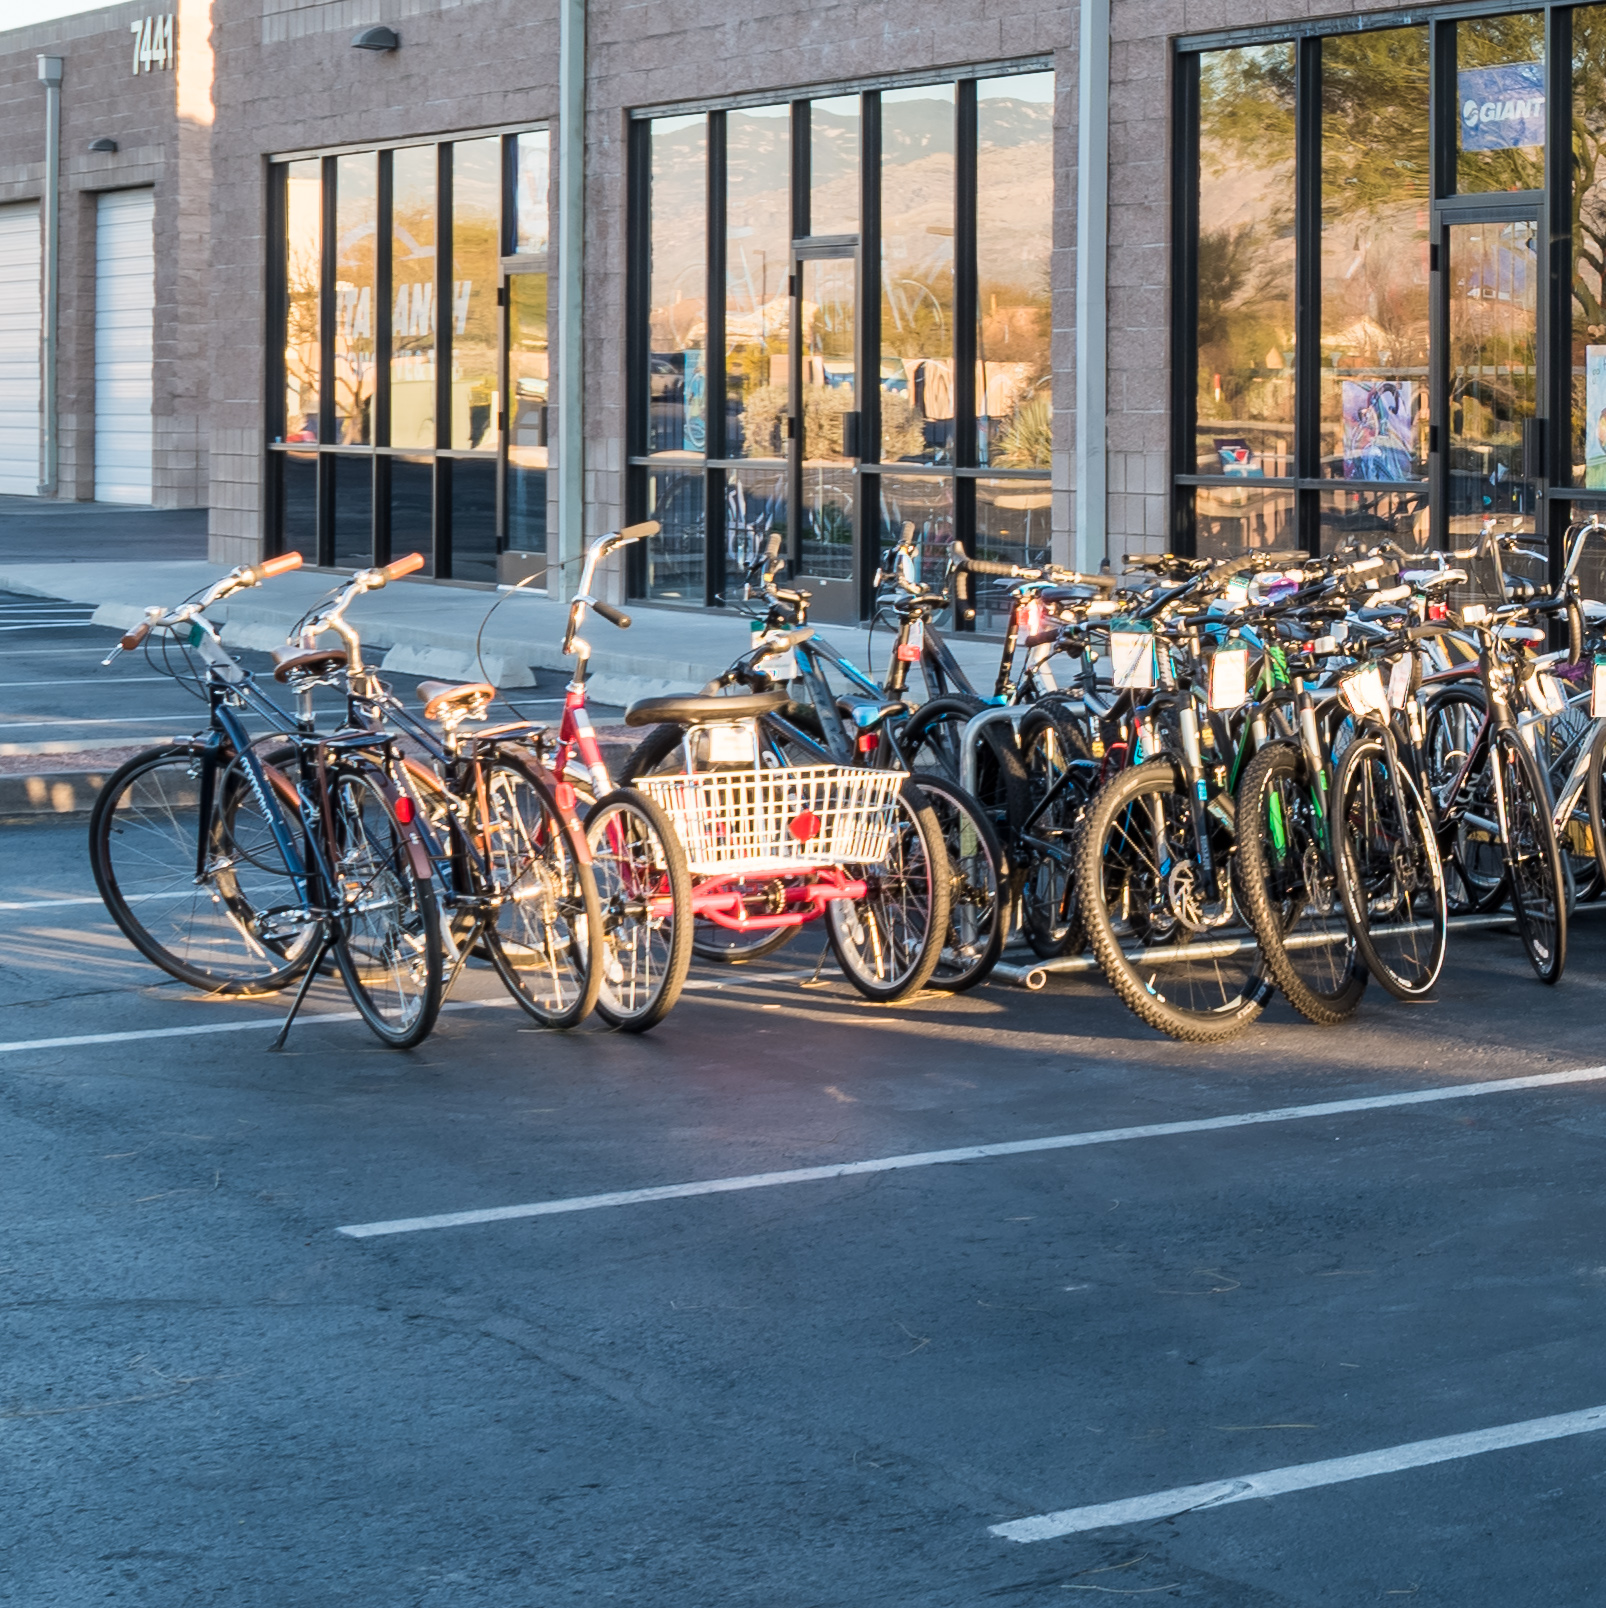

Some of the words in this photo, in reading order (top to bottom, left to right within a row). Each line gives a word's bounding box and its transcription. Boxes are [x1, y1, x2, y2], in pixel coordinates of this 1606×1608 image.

[130, 13, 175, 76] 7441
[1479, 96, 1546, 123] GIANT
[335, 282, 371, 339] ITA
[391, 278, 472, 337] ANH
